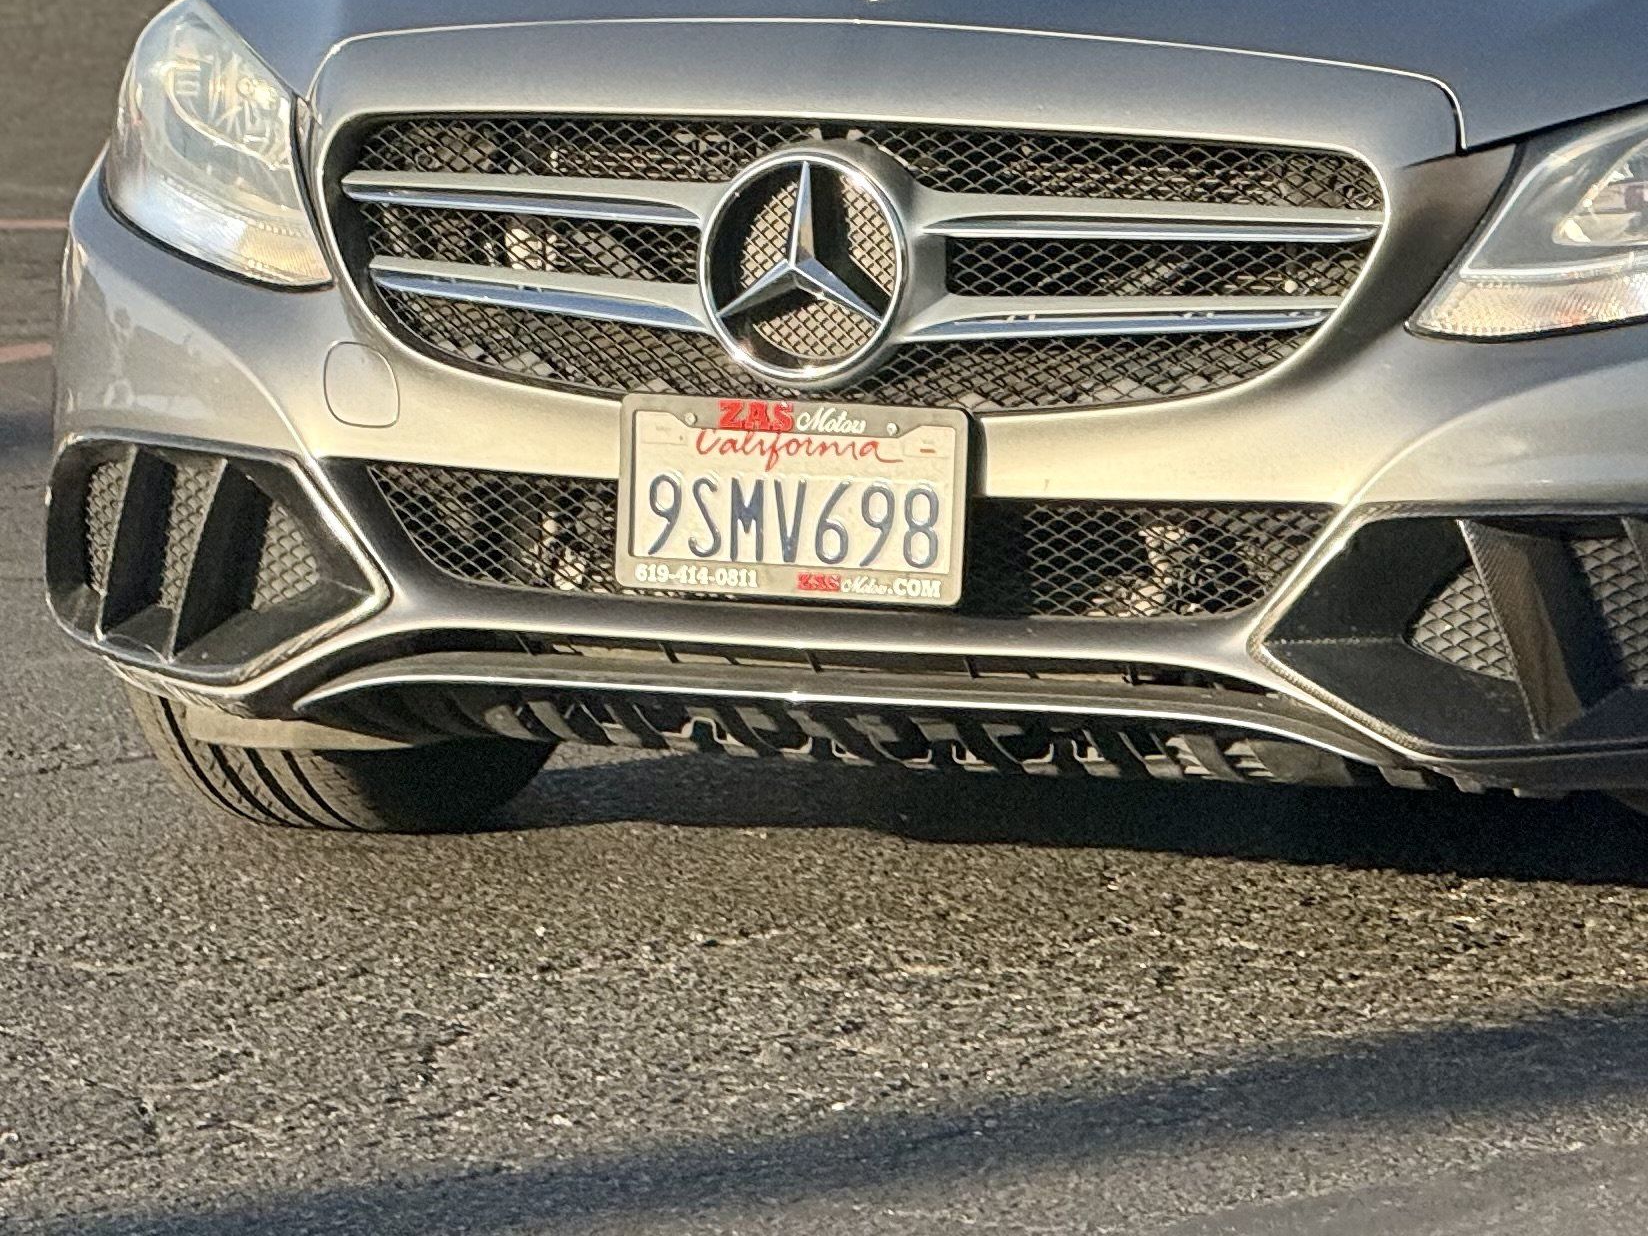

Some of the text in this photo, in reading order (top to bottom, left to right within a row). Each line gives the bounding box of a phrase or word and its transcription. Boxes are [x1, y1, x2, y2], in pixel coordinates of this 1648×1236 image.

[718, 399, 795, 432] ZAS
[696, 428, 904, 472] California
[647, 473, 941, 570] 9SMV698
[634, 564, 759, 589] 619-414-0811
